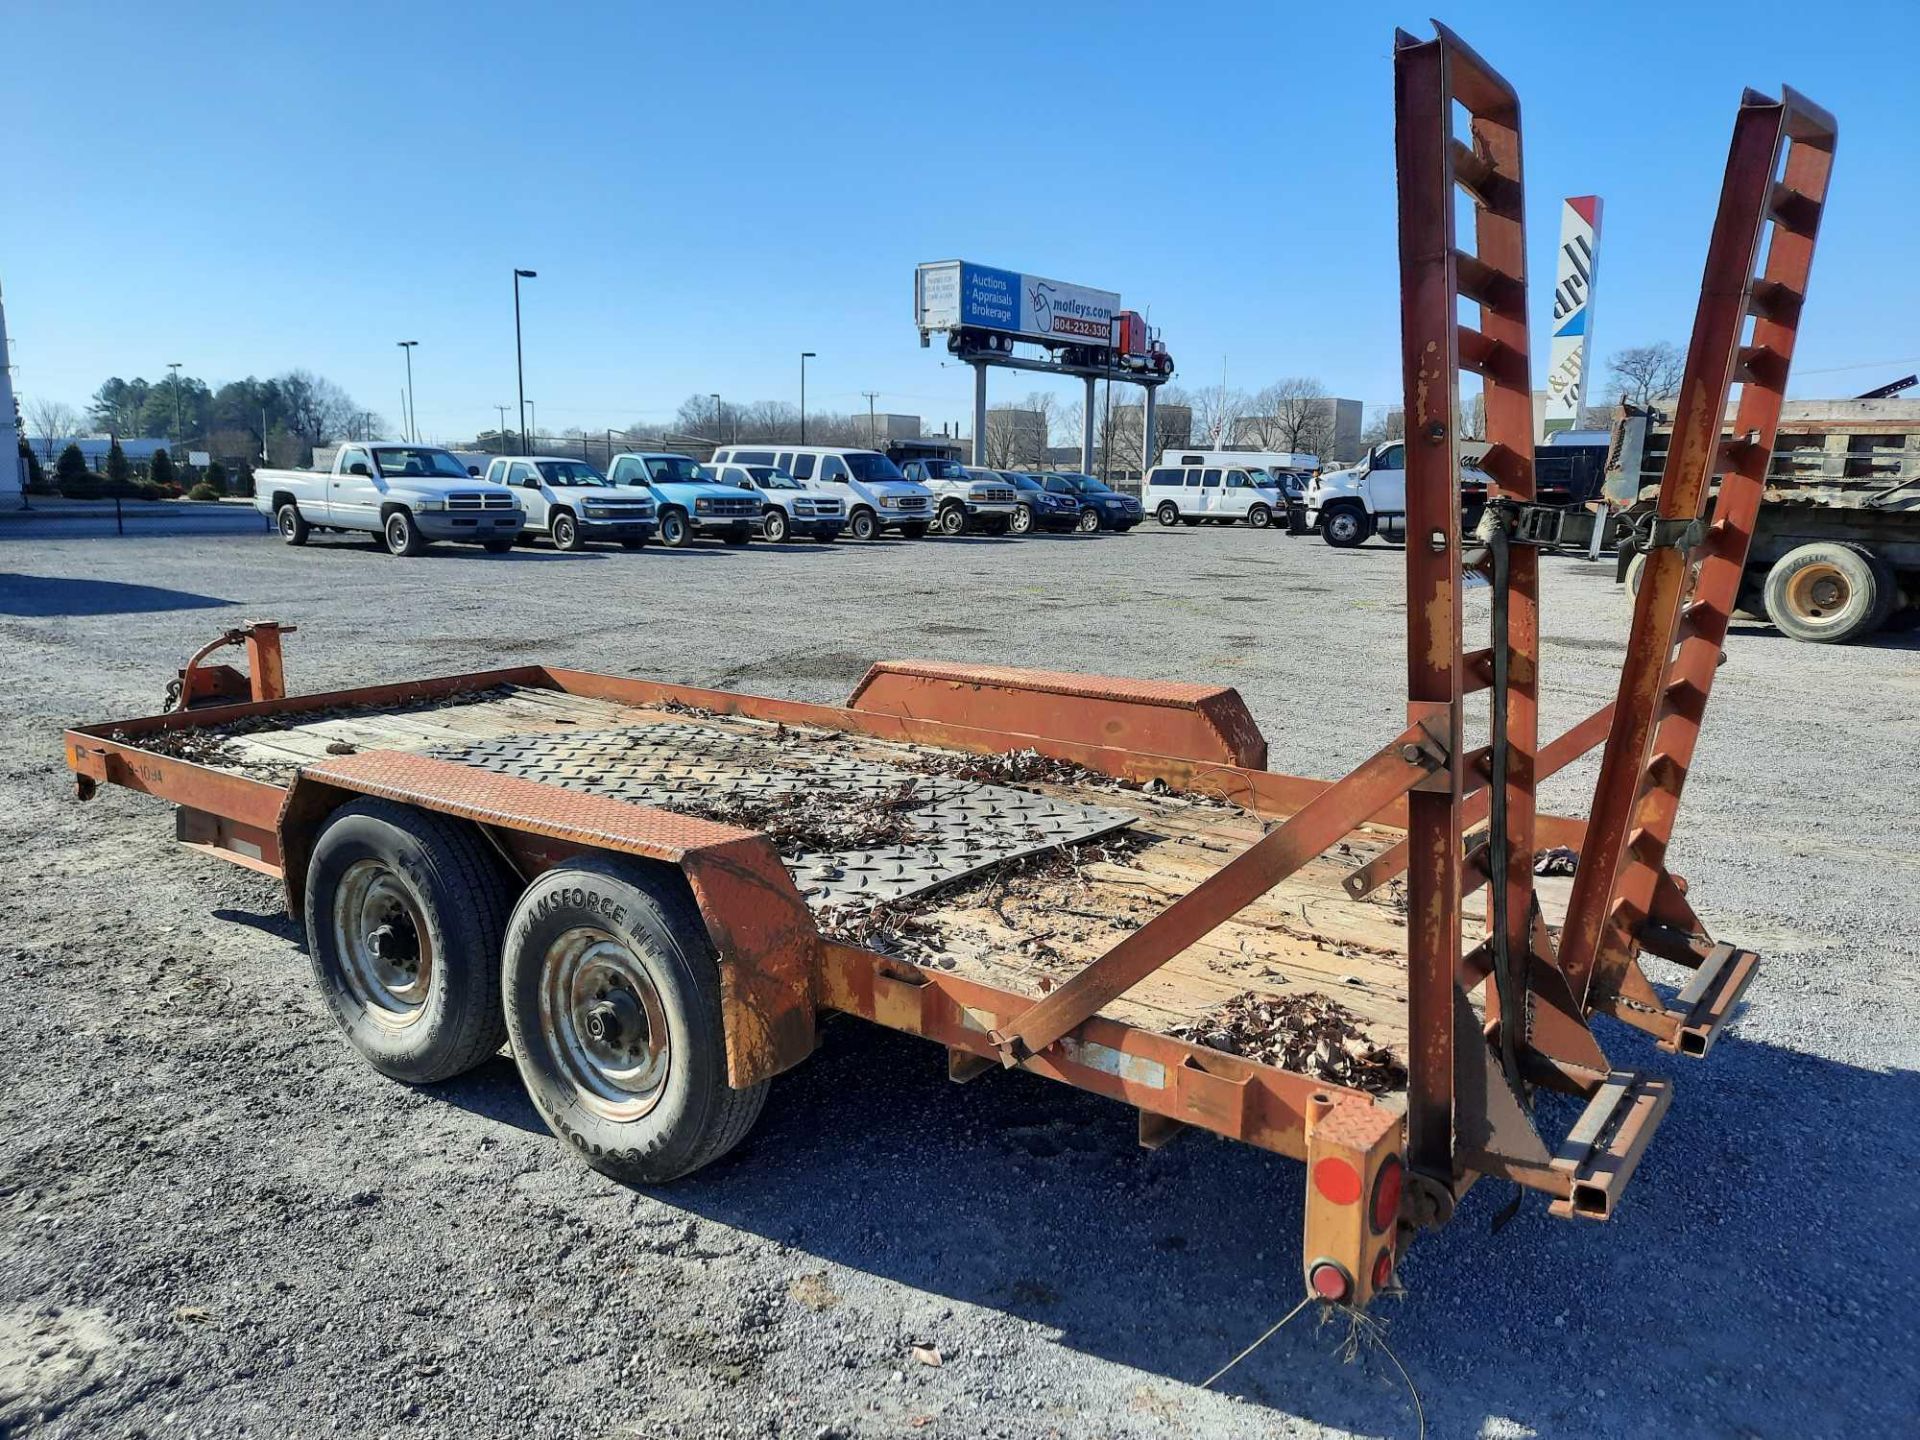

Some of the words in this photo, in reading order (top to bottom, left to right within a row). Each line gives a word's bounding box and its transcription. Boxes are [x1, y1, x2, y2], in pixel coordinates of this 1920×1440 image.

[973, 274, 1007, 290] Auctions
[972, 288, 1013, 306] Appraisals
[973, 304, 1012, 322] Brokerage
[1053, 298, 1112, 320] motleys.com
[1548, 375, 1569, 393] &
[516, 887, 628, 940] RANSFORCE
